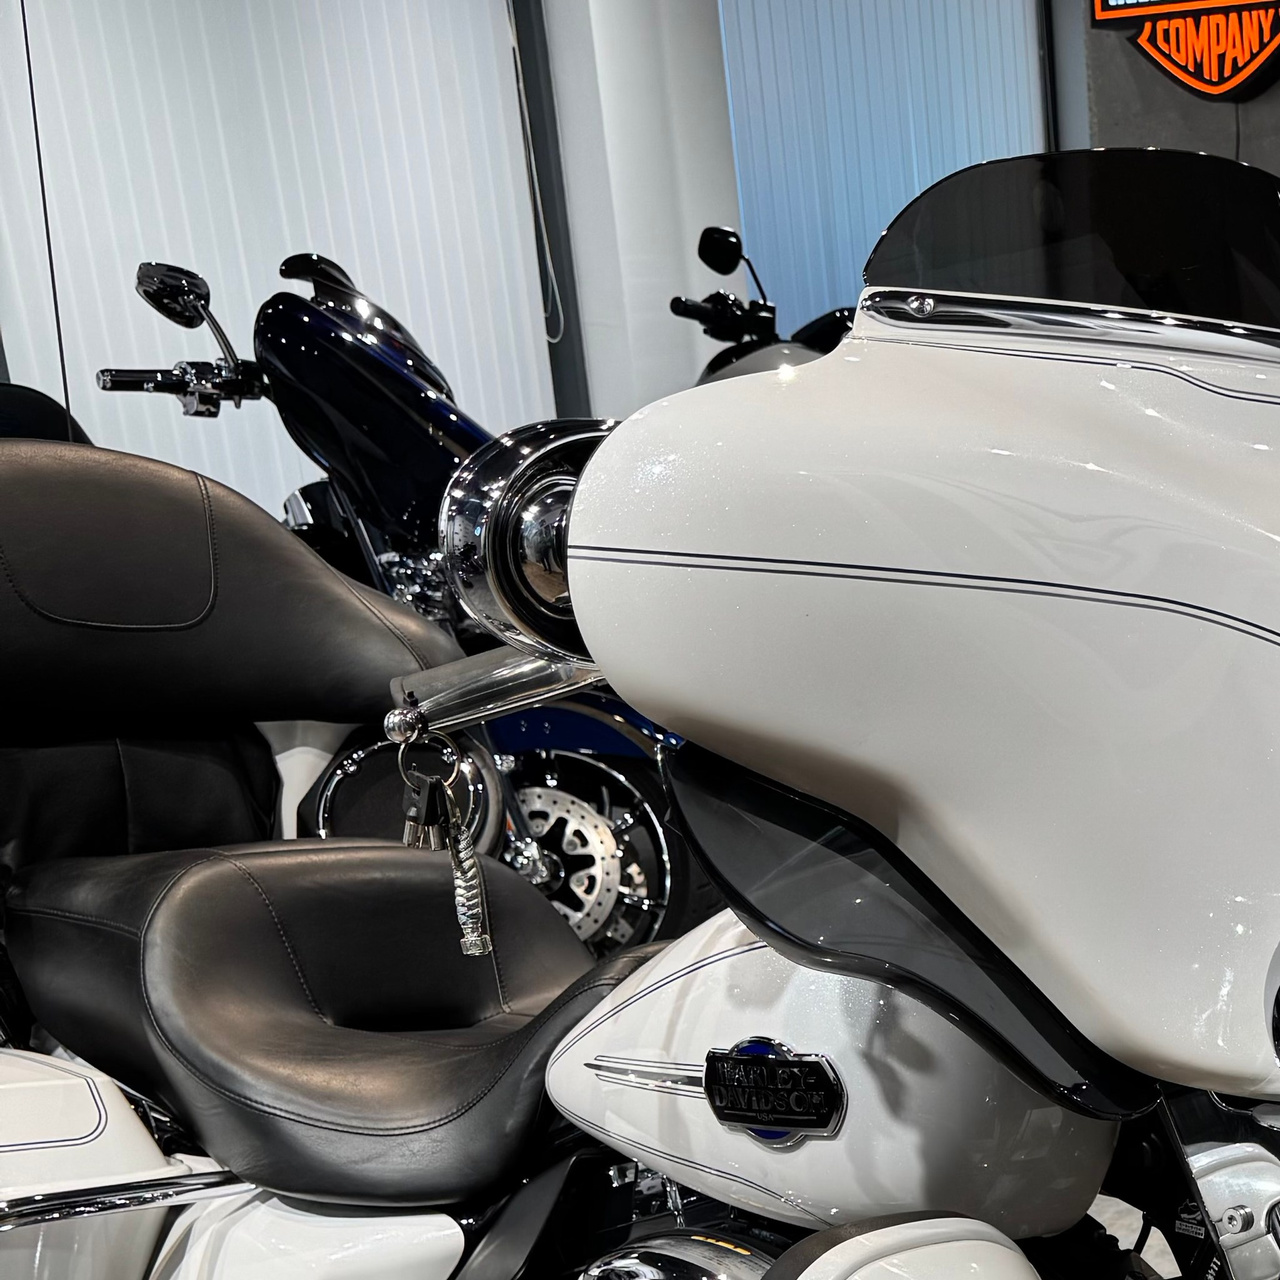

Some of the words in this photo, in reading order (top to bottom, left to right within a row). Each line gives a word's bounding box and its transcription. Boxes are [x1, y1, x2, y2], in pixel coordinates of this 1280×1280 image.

[1156, 8, 1276, 82] COMPANY
[714, 1089, 828, 1113] DAVIDSON
[757, 1113, 775, 1122] USA
